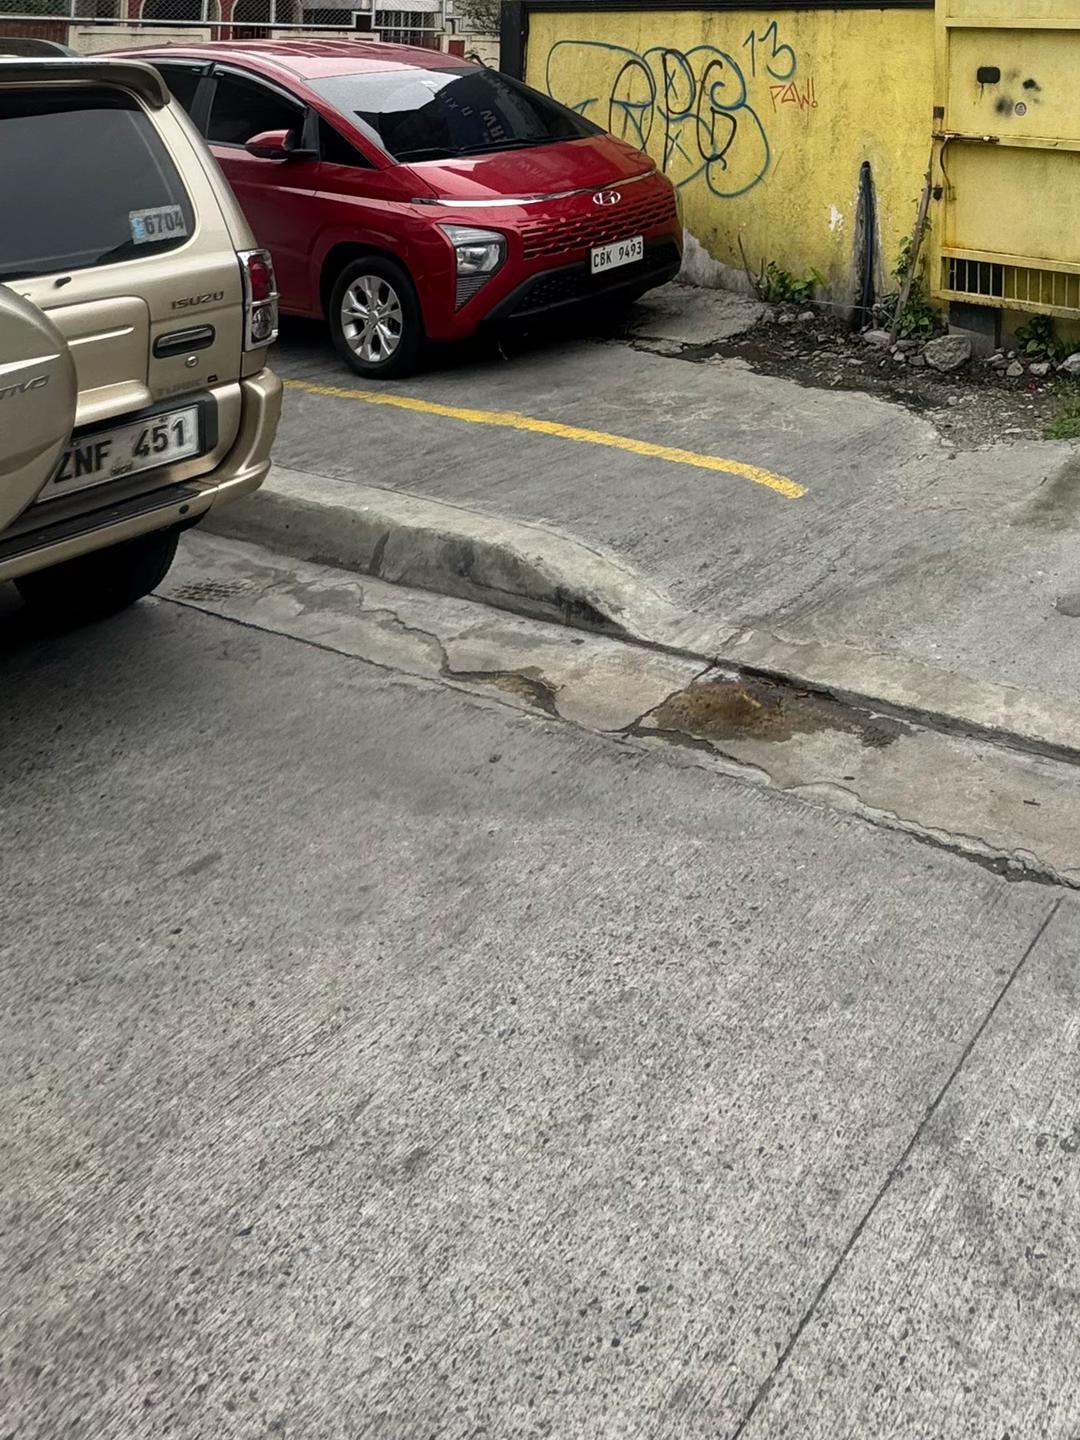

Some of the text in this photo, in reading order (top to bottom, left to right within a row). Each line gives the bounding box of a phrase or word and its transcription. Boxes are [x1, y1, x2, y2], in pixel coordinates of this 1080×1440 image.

[743, 21, 796, 80] 13
[144, 211, 185, 235] 6704
[593, 241, 642, 268] CBK 9493
[171, 291, 224, 310] ISUZU
[54, 418, 187, 484] ZNF 451
